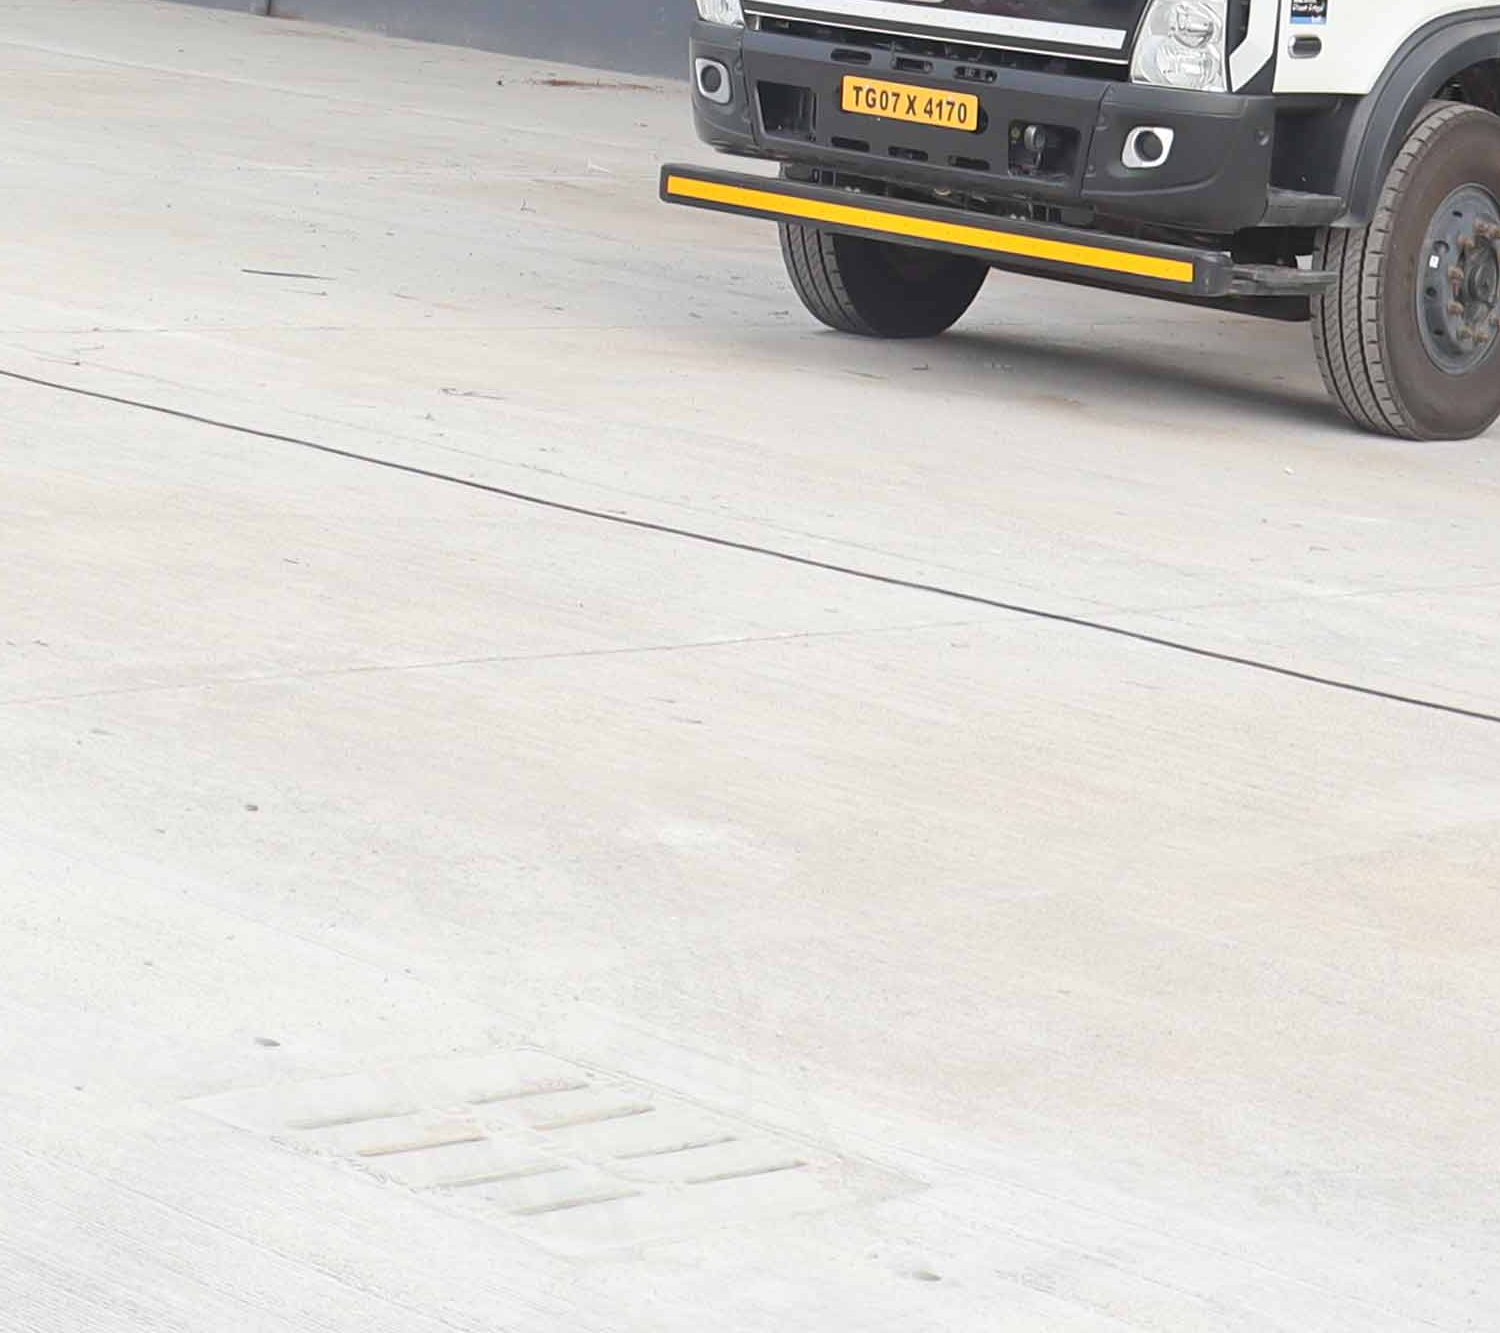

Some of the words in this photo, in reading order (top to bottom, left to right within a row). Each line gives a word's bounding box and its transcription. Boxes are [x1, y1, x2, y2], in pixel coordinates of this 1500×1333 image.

[852, 85, 900, 114] TG07
[905, 93, 917, 117] X
[923, 96, 968, 125] 4170
